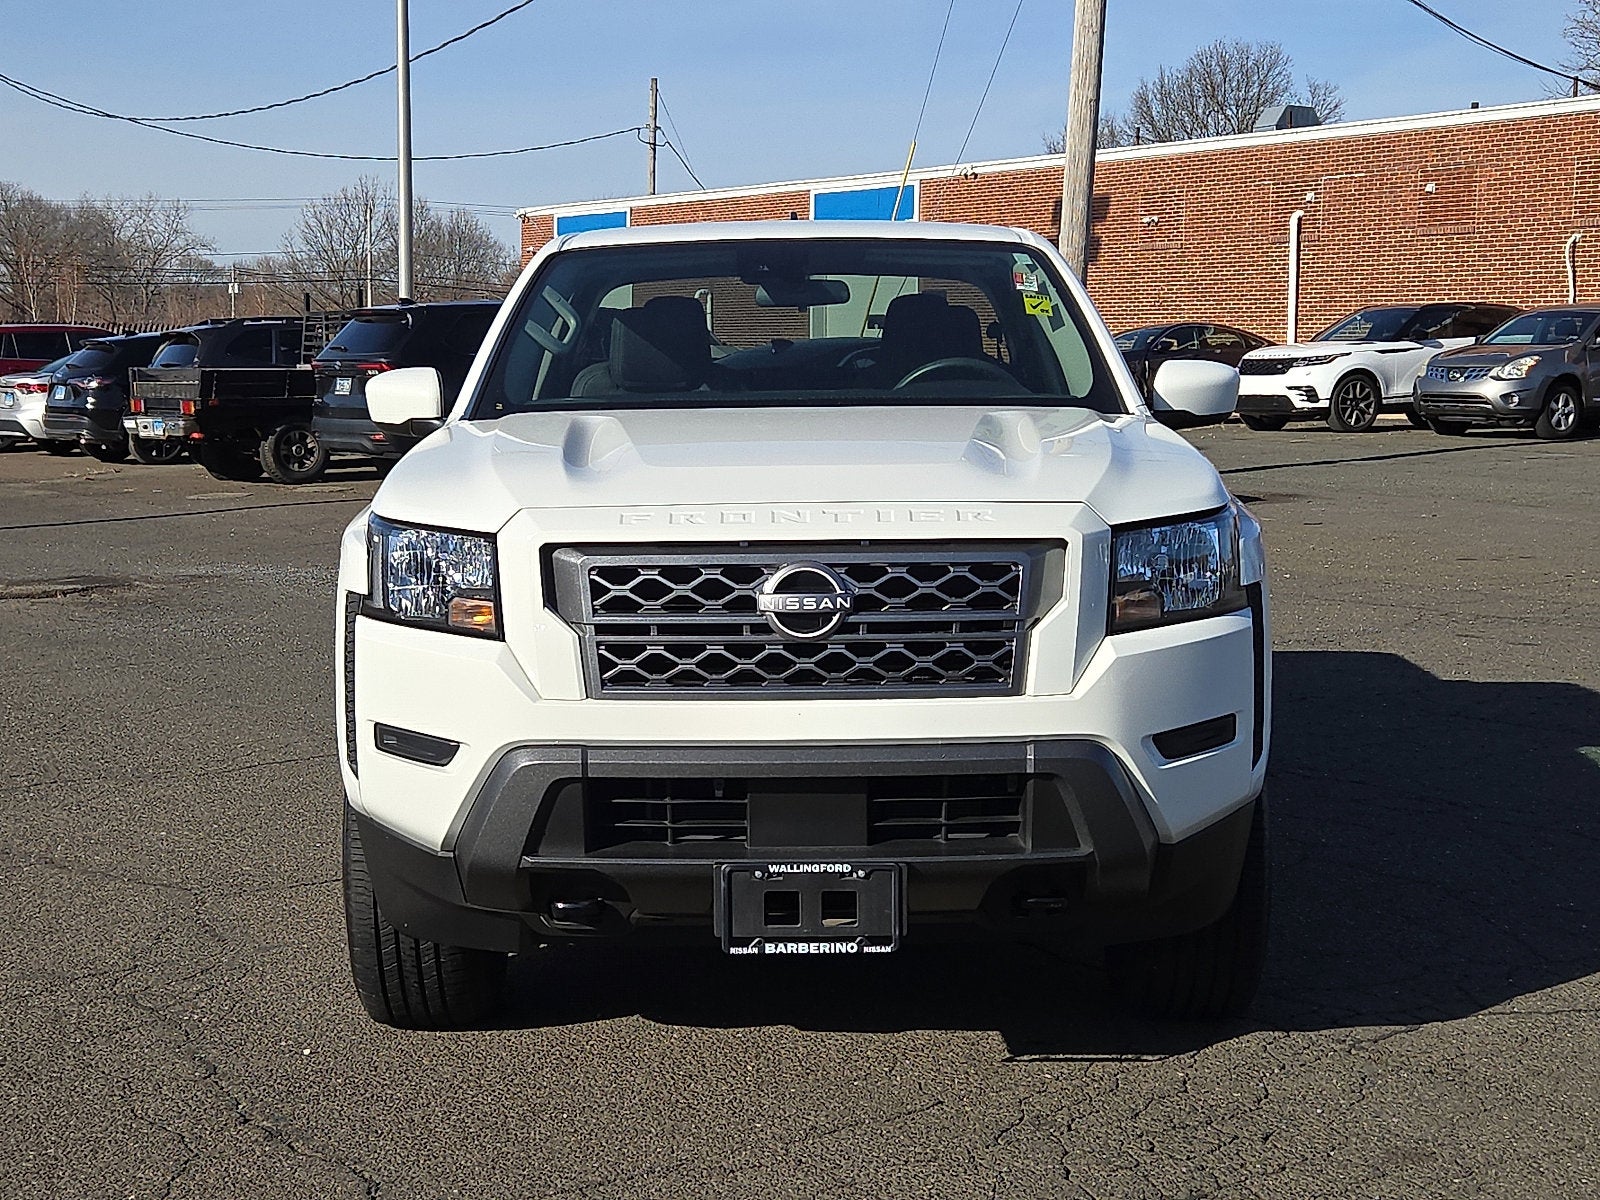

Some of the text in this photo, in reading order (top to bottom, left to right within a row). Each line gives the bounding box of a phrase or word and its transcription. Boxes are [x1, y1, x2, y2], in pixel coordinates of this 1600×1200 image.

[619, 508, 997, 526] FRONTIER
[758, 595, 851, 610] NISSAN
[768, 863, 852, 874] WALLINGFORD
[764, 942, 858, 954] BARBERINO
